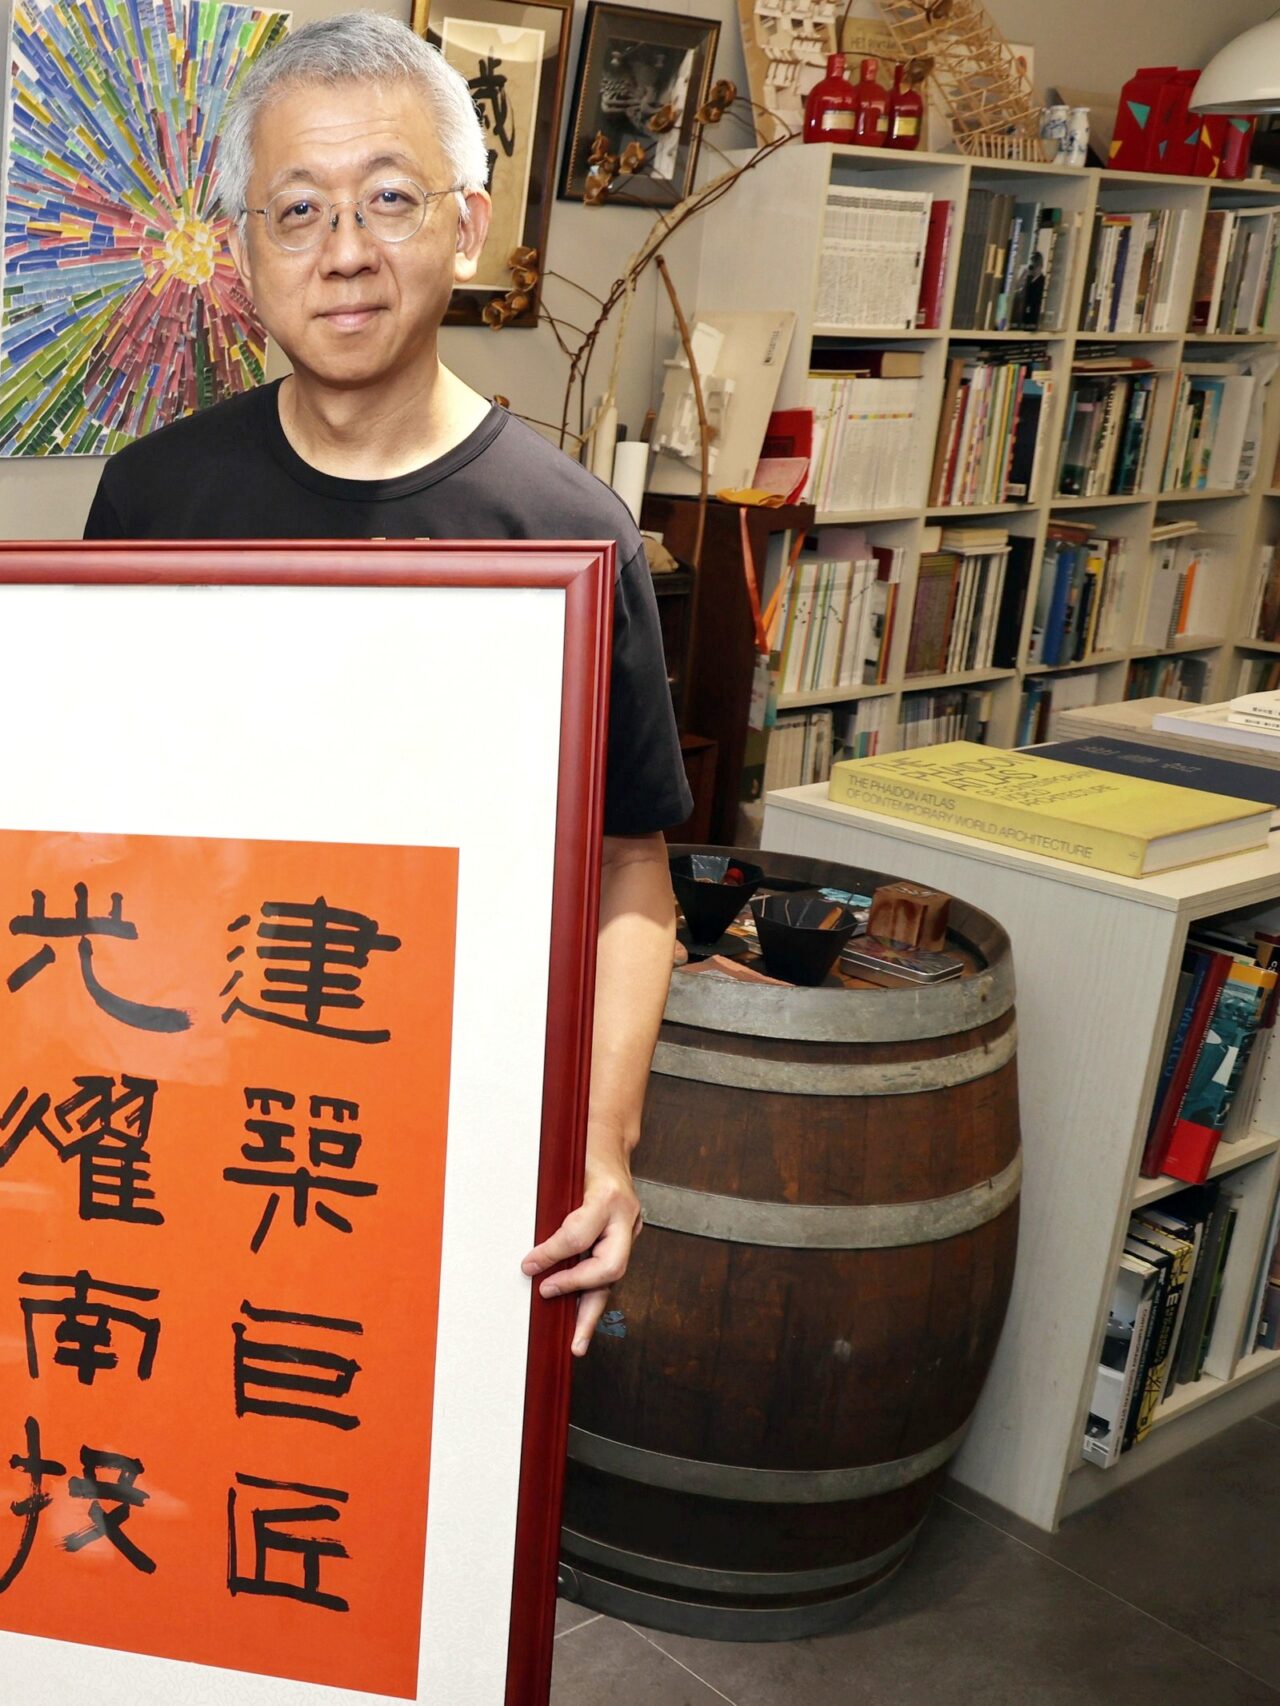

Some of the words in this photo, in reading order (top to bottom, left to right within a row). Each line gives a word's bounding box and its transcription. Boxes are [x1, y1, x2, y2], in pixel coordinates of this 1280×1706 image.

[846, 788, 861, 798] OF
[862, 791, 955, 823] CONTEMPORARY
[956, 816, 998, 834] WORLD
[999, 825, 1094, 859] ARCHITECTURE
[848, 775, 869, 789] THE
[870, 780, 919, 801] PHAIDON
[921, 793, 956, 810] ATLAS
[222, 896, 401, 1611] 建築巨匠
